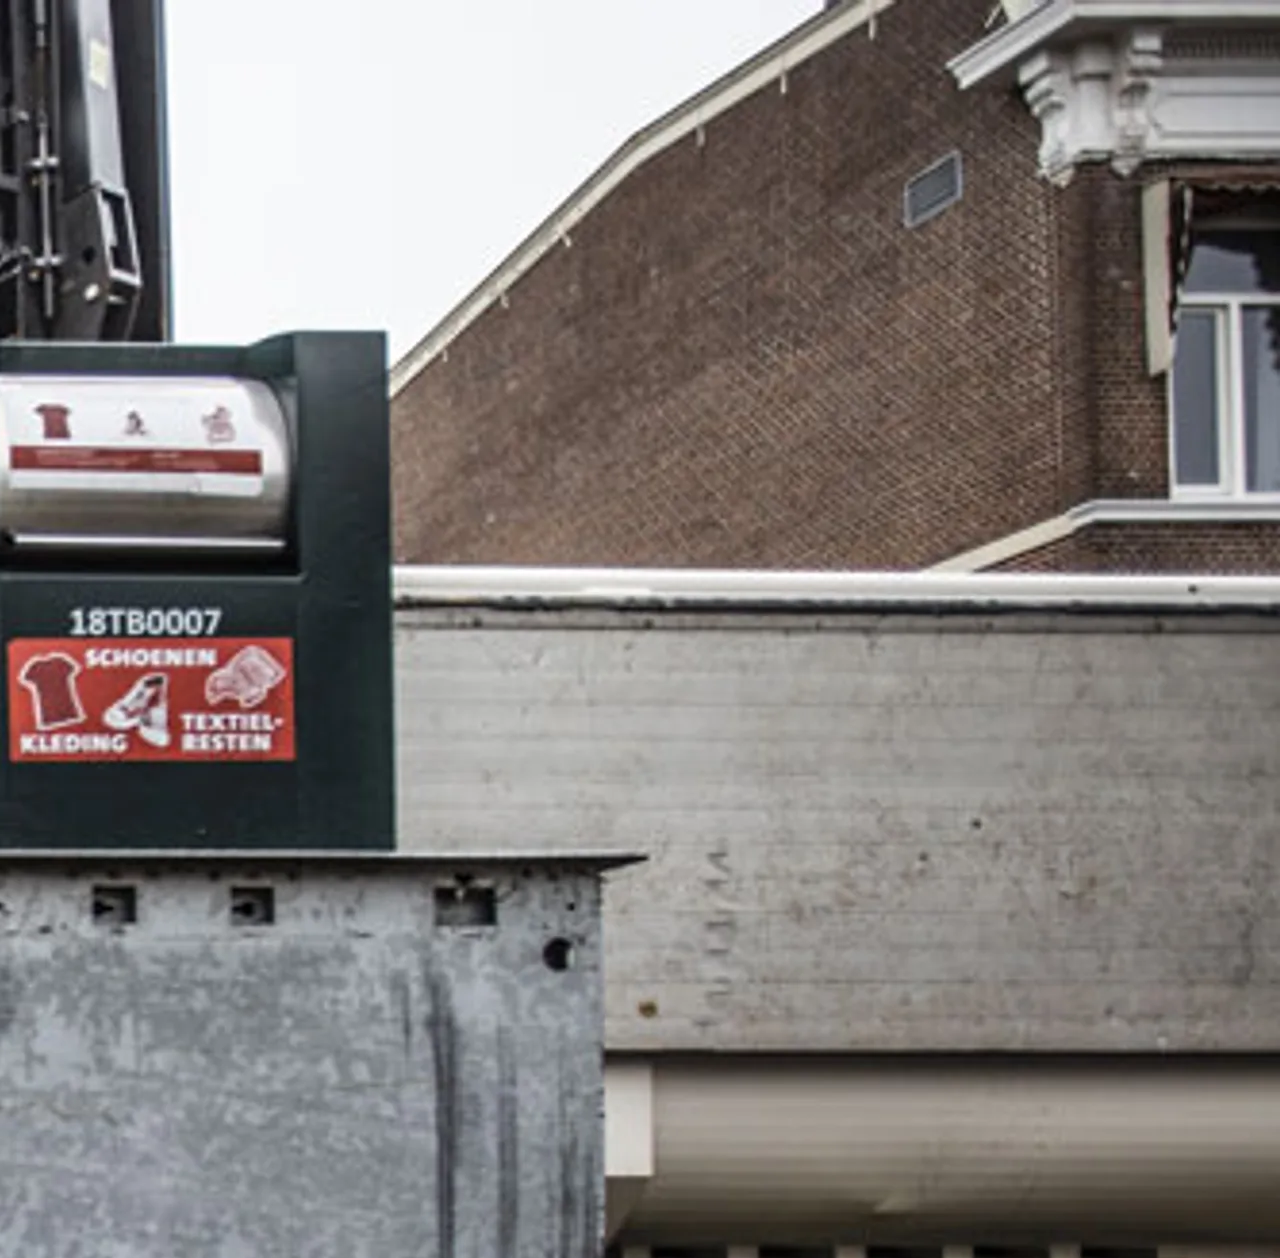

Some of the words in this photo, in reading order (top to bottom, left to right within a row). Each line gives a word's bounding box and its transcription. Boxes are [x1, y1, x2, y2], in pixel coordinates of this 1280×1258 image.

[69, 607, 223, 636] 18TB0007
[85, 649, 218, 667] SCHOENEN
[180, 712, 284, 732] TEXTIEL-
[19, 732, 128, 754] KLEDING
[181, 733, 272, 752] RESTEN
